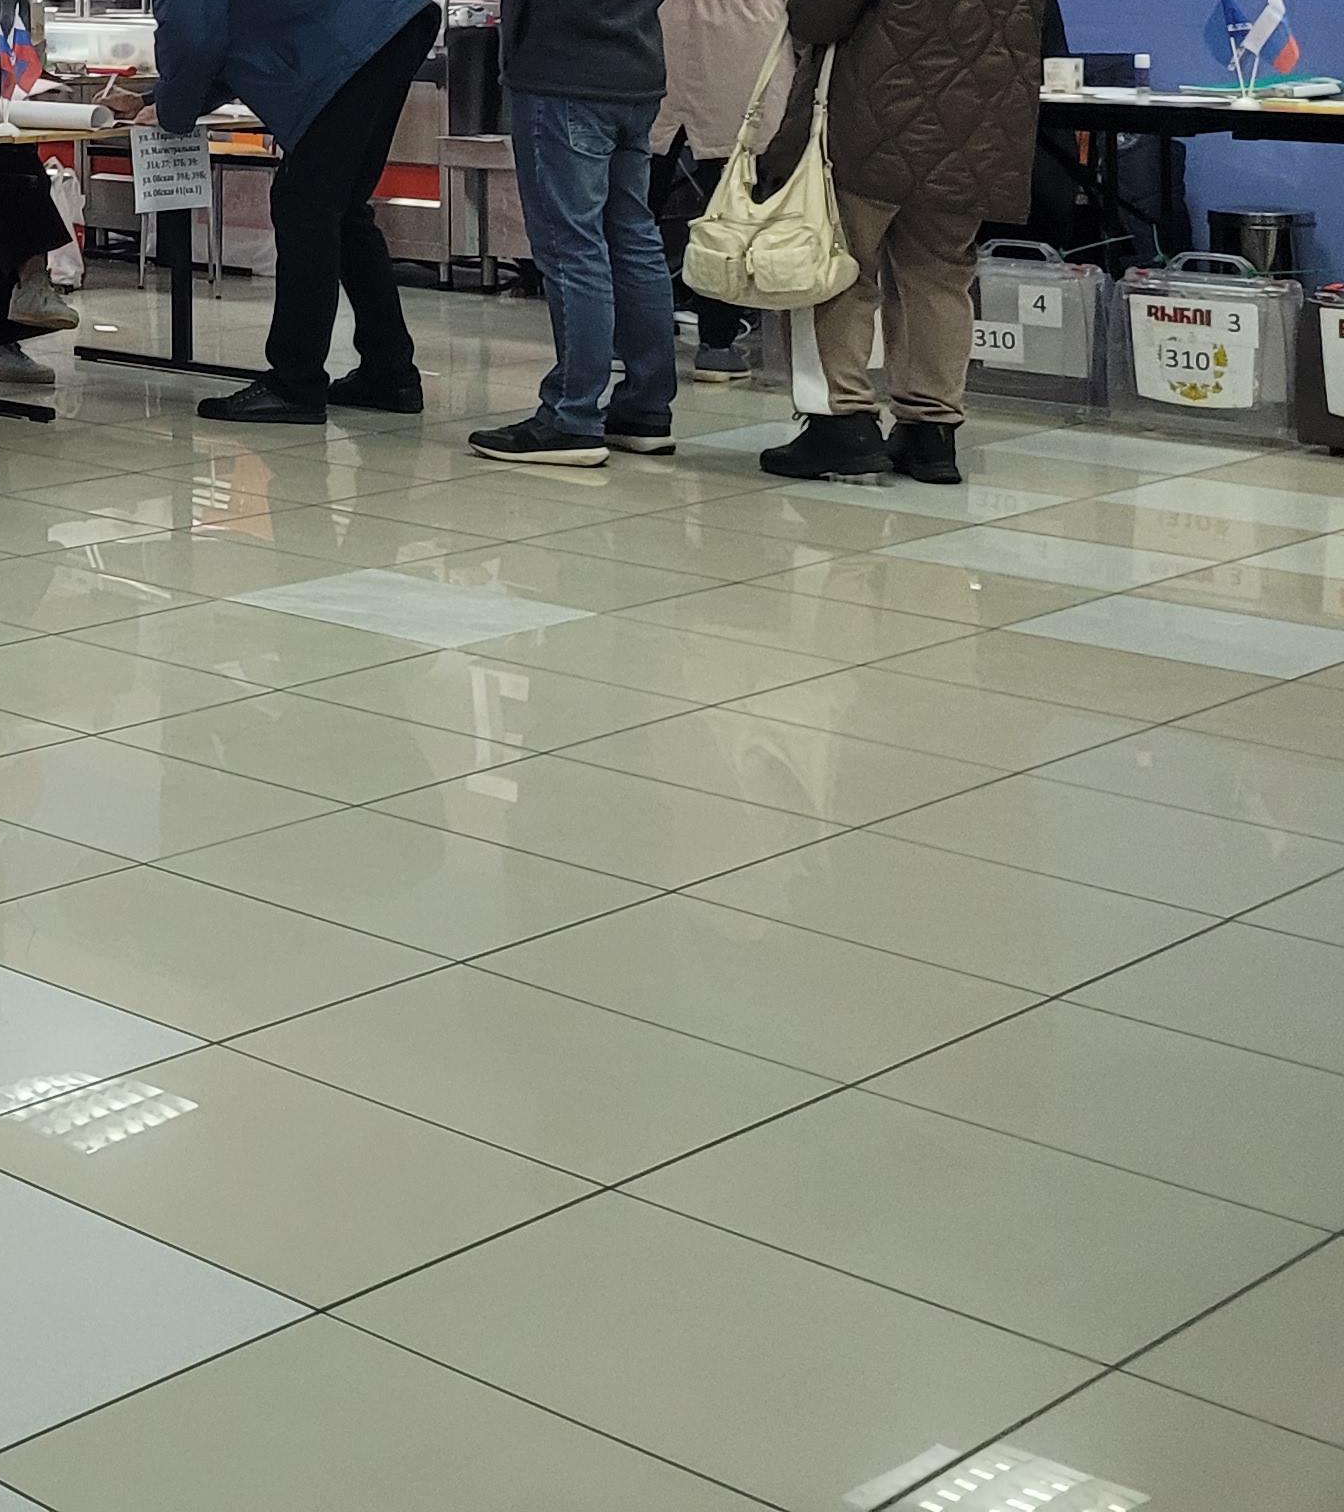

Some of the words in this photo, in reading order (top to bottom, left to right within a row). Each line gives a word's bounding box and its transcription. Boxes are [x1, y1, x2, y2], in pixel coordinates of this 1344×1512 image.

[1032, 294, 1047, 314] 4
[1227, 313, 1241, 333] 3
[973, 328, 1016, 350] 310
[1165, 349, 1210, 372] 310
